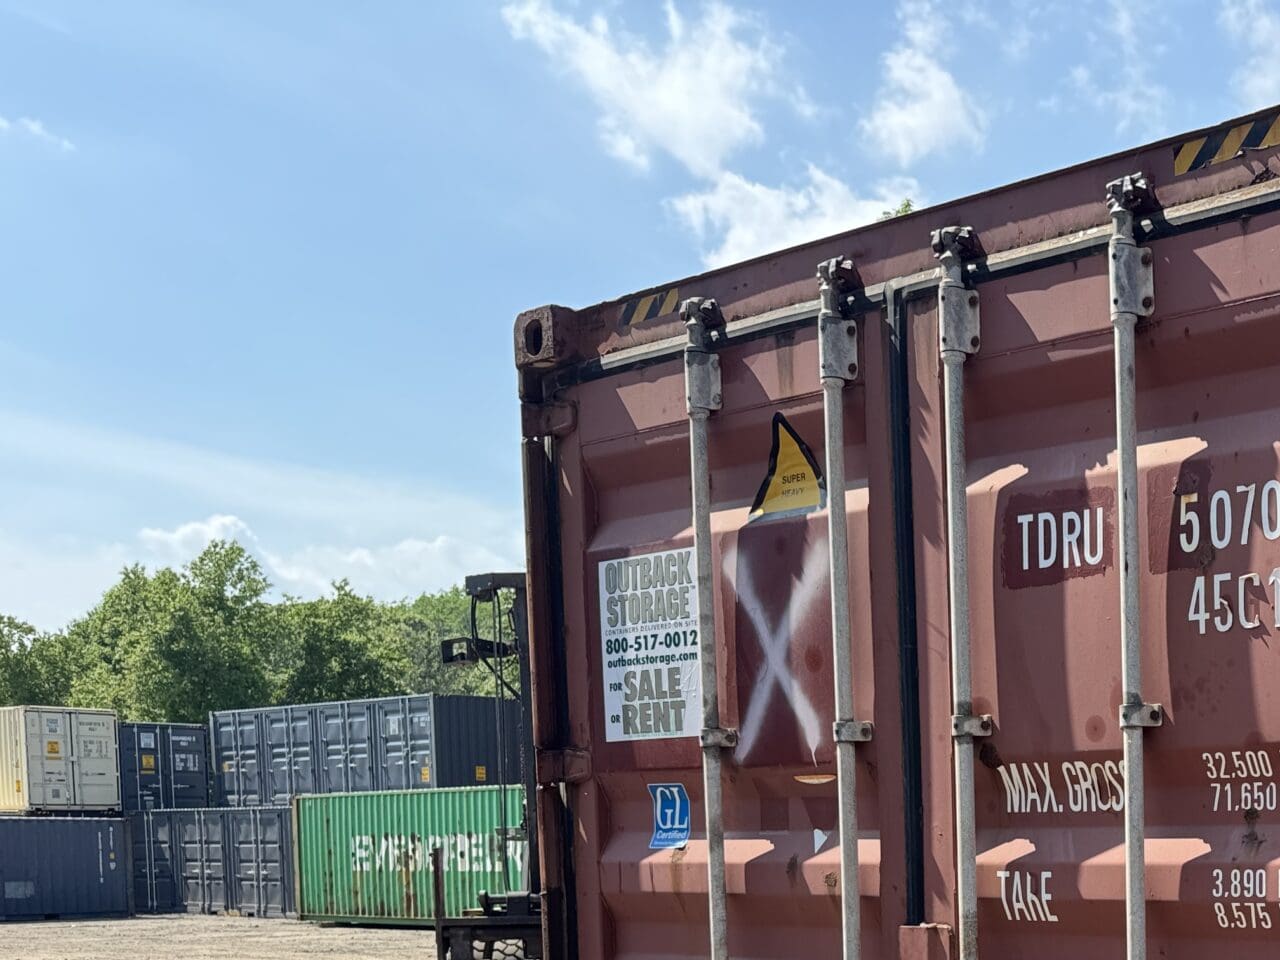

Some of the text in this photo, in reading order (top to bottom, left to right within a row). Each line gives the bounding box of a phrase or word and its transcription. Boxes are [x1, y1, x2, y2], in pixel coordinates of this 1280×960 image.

[781, 472, 806, 485] SUPER
[1017, 507, 1105, 570] TDRU
[605, 551, 693, 594] OUTBACK
[606, 629, 699, 655] 800-517-0012
[640, 623, 672, 632] DELIVERED
[674, 621, 683, 629] ON
[607, 652, 698, 668] outbackstorage.com
[609, 666, 682, 702] FOR SALE
[610, 700, 686, 735] OR RENT
[996, 762, 1063, 813] MAX.
[1210, 782, 1277, 812] 71,650
[656, 786, 689, 830] GL
[656, 830, 688, 840] Certified
[1212, 868, 1266, 899] 3,890
